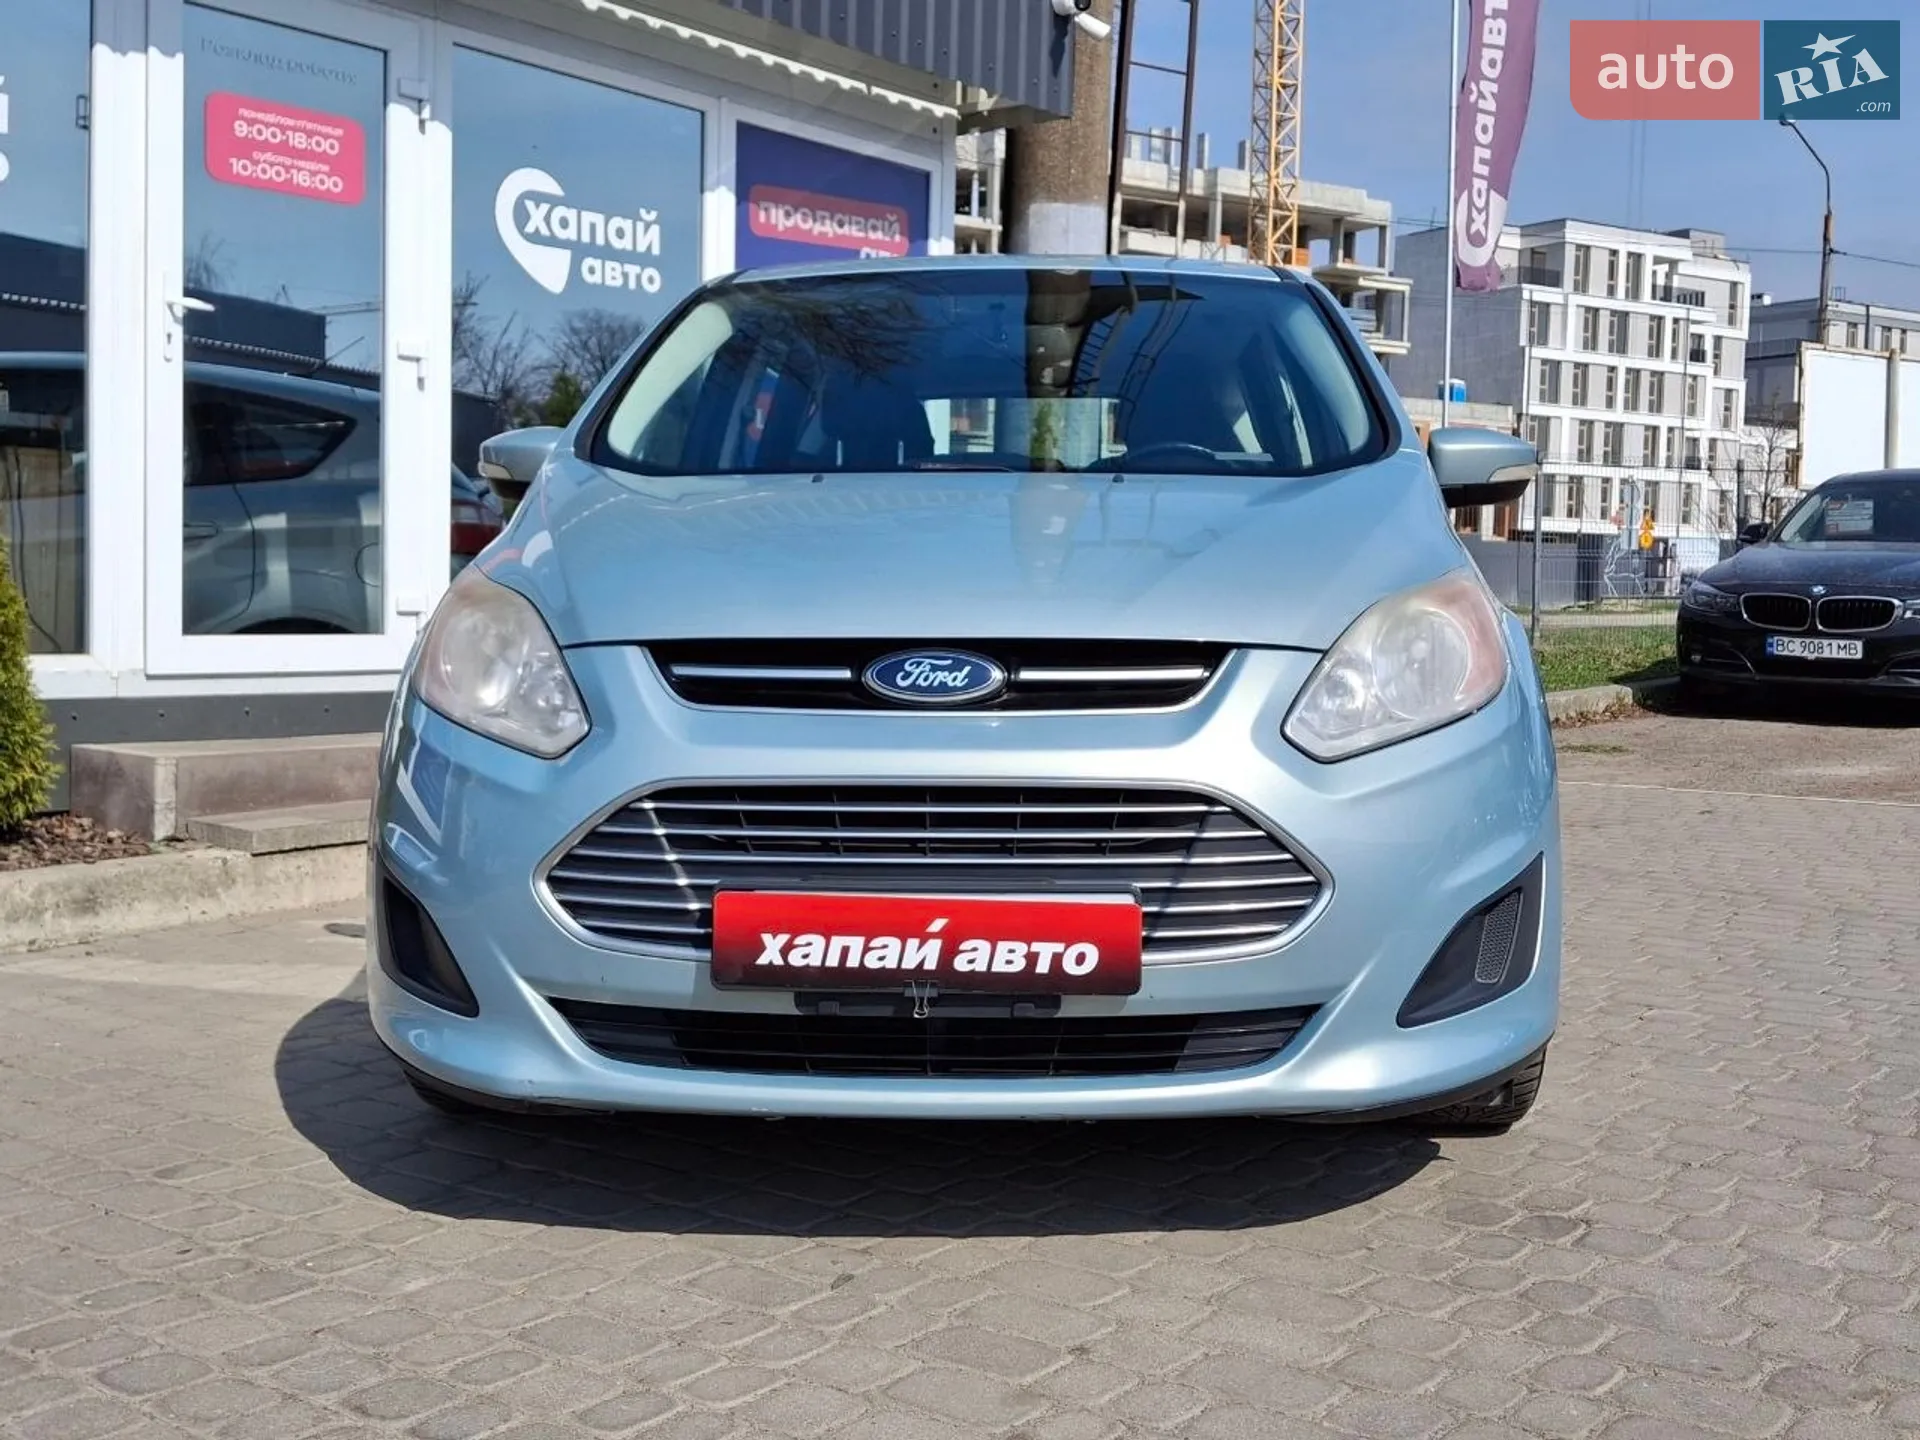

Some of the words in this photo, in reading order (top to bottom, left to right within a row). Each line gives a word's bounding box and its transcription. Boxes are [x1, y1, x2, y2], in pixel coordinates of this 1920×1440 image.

[523, 199, 661, 256] хапай
[758, 200, 901, 243] продавай
[580, 256, 662, 294] авто
[1775, 638, 1796, 654] BC
[1799, 640, 1834, 656] 9081
[1837, 642, 1859, 657] MB
[895, 657, 973, 688] Ford
[952, 937, 1100, 977] авто
